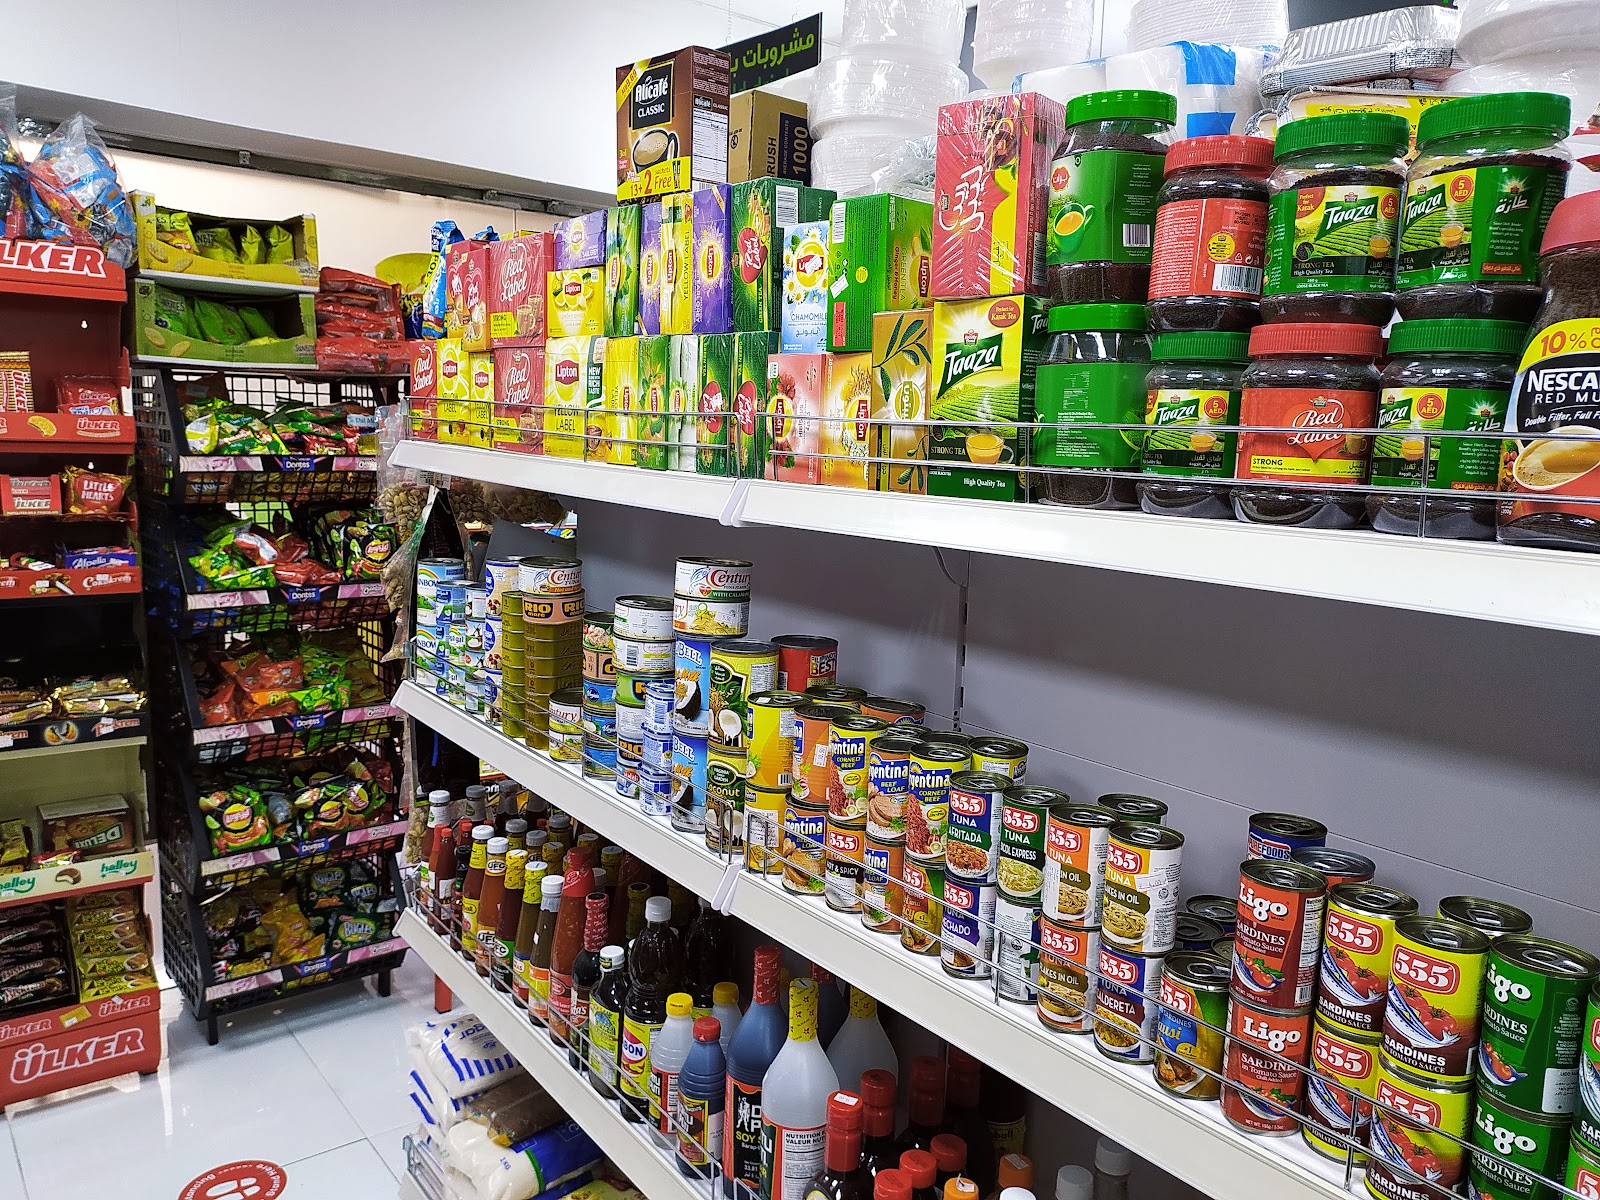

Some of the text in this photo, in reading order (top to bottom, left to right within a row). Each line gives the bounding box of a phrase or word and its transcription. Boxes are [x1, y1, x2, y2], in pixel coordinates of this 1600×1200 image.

[743, 28, 815, 69] مشروبات
[635, 75, 668, 105] Alicafé
[638, 103, 665, 119] CLASSIC
[793, 125, 808, 175] 1000
[655, 166, 671, 175] sachets
[630, 169, 652, 197] 13+ 2
[654, 174, 672, 190] Free
[1458, 180, 1464, 190] 5
[1299, 193, 1314, 201] Perfect
[1454, 188, 1469, 197] AED
[1297, 203, 1315, 212] Karak
[1387, 198, 1393, 208] 5
[1406, 191, 1443, 226] Taaza
[1495, 194, 1528, 215] طازة
[1324, 202, 1375, 231] Taaza
[505, 255, 524, 282] Red
[1294, 262, 1321, 270] STRONG
[500, 276, 527, 302] Label
[565, 285, 581, 295] Lipton
[790, 313, 828, 321] CHAMOMILE
[991, 312, 1016, 321] Karak Tea
[416, 355, 431, 374] Red
[443, 365, 457, 374] Lipton
[588, 367, 601, 376] NEW
[944, 345, 999, 385] Taaza
[475, 375, 488, 384] Lipton
[508, 367, 528, 387] Red
[556, 366, 578, 379] Lipton
[413, 373, 433, 392] Label
[588, 380, 600, 388] RICH
[504, 384, 531, 408] Label
[588, 387, 600, 395] TASTE
[1534, 393, 1566, 404] RED
[444, 403, 457, 413] LABEL
[1420, 404, 1438, 414] AED
[1427, 398, 1434, 406] 5
[476, 410, 488, 420] LABEL
[1156, 404, 1196, 425] Taaza
[1301, 408, 1337, 427] Red
[1378, 405, 1407, 426] Taaza
[1525, 411, 1591, 427] Double Filter, Full
[77, 417, 121, 430] ÜLKER
[555, 418, 576, 432] LABEL
[930, 447, 966, 456] STRONG TEA
[286, 460, 309, 469] Doritos
[1252, 458, 1283, 466] STRONG
[83, 480, 115, 492] LITTLE
[963, 477, 1006, 488] High Quality Tea
[81, 491, 114, 502] HEARTS
[291, 591, 316, 600] Doritos
[524, 602, 551, 614] RIO
[810, 659, 836, 675] BEST
[297, 718, 320, 727] Doritos
[673, 738, 695, 761] BELL
[918, 789, 947, 797] CORNED
[951, 792, 983, 813] 555
[952, 812, 977, 827] TUNA
[1004, 809, 1037, 830] 555
[829, 834, 857, 850] 555
[1004, 829, 1030, 844] TUNA
[1049, 827, 1079, 851] 555
[301, 842, 325, 852] Doritos
[1012, 846, 1036, 861] EXPRESS
[1049, 850, 1073, 865] TUNA
[1107, 844, 1138, 872] 555
[100, 860, 138, 878] halley
[487, 862, 505, 870] UFC
[835, 864, 859, 876] & SPICY
[868, 875, 883, 883] LOAF
[1060, 869, 1082, 883] IN OIL
[1106, 871, 1131, 886] TUNA
[945, 883, 971, 908] 555
[1118, 889, 1139, 905] IN OIL
[1239, 882, 1288, 922] Ligo
[344, 921, 373, 936] BUGLES
[1237, 919, 1286, 946] SARDINES
[1327, 917, 1375, 950] 555
[1043, 929, 1077, 954] 555
[1242, 932, 1283, 954] Tomato Sauce
[304, 962, 327, 973] Doritos
[1100, 952, 1135, 979] 555
[1395, 951, 1450, 987] 555
[1056, 971, 1079, 986] IN OIL
[1487, 962, 1532, 1004] igo
[99, 995, 151, 1018] ÜLKER
[1160, 985, 1190, 1013] 555
[1319, 995, 1372, 1023] SARDINES
[1323, 1007, 1372, 1030] TOMATO SAUCE
[0, 1018, 52, 1041] ÜLKER
[1242, 1016, 1301, 1053] Ligo
[1500, 1027, 1525, 1043] Sauce
[10, 1027, 145, 1084] ÜLKER
[1314, 1038, 1365, 1073] 555
[1384, 1034, 1446, 1067] SARDINES
[1241, 1052, 1299, 1072] SARDINE
[1390, 1048, 1445, 1074] TOMATO SAUCE
[1248, 1064, 1297, 1079] Tomato Sauce
[786, 1132, 821, 1140] NUTRITION
[1476, 1102, 1537, 1155] Ligo
[735, 1130, 756, 1144] SOY
[786, 1136, 810, 1145] VALEUR
[1504, 1179, 1531, 1194] Sauce
